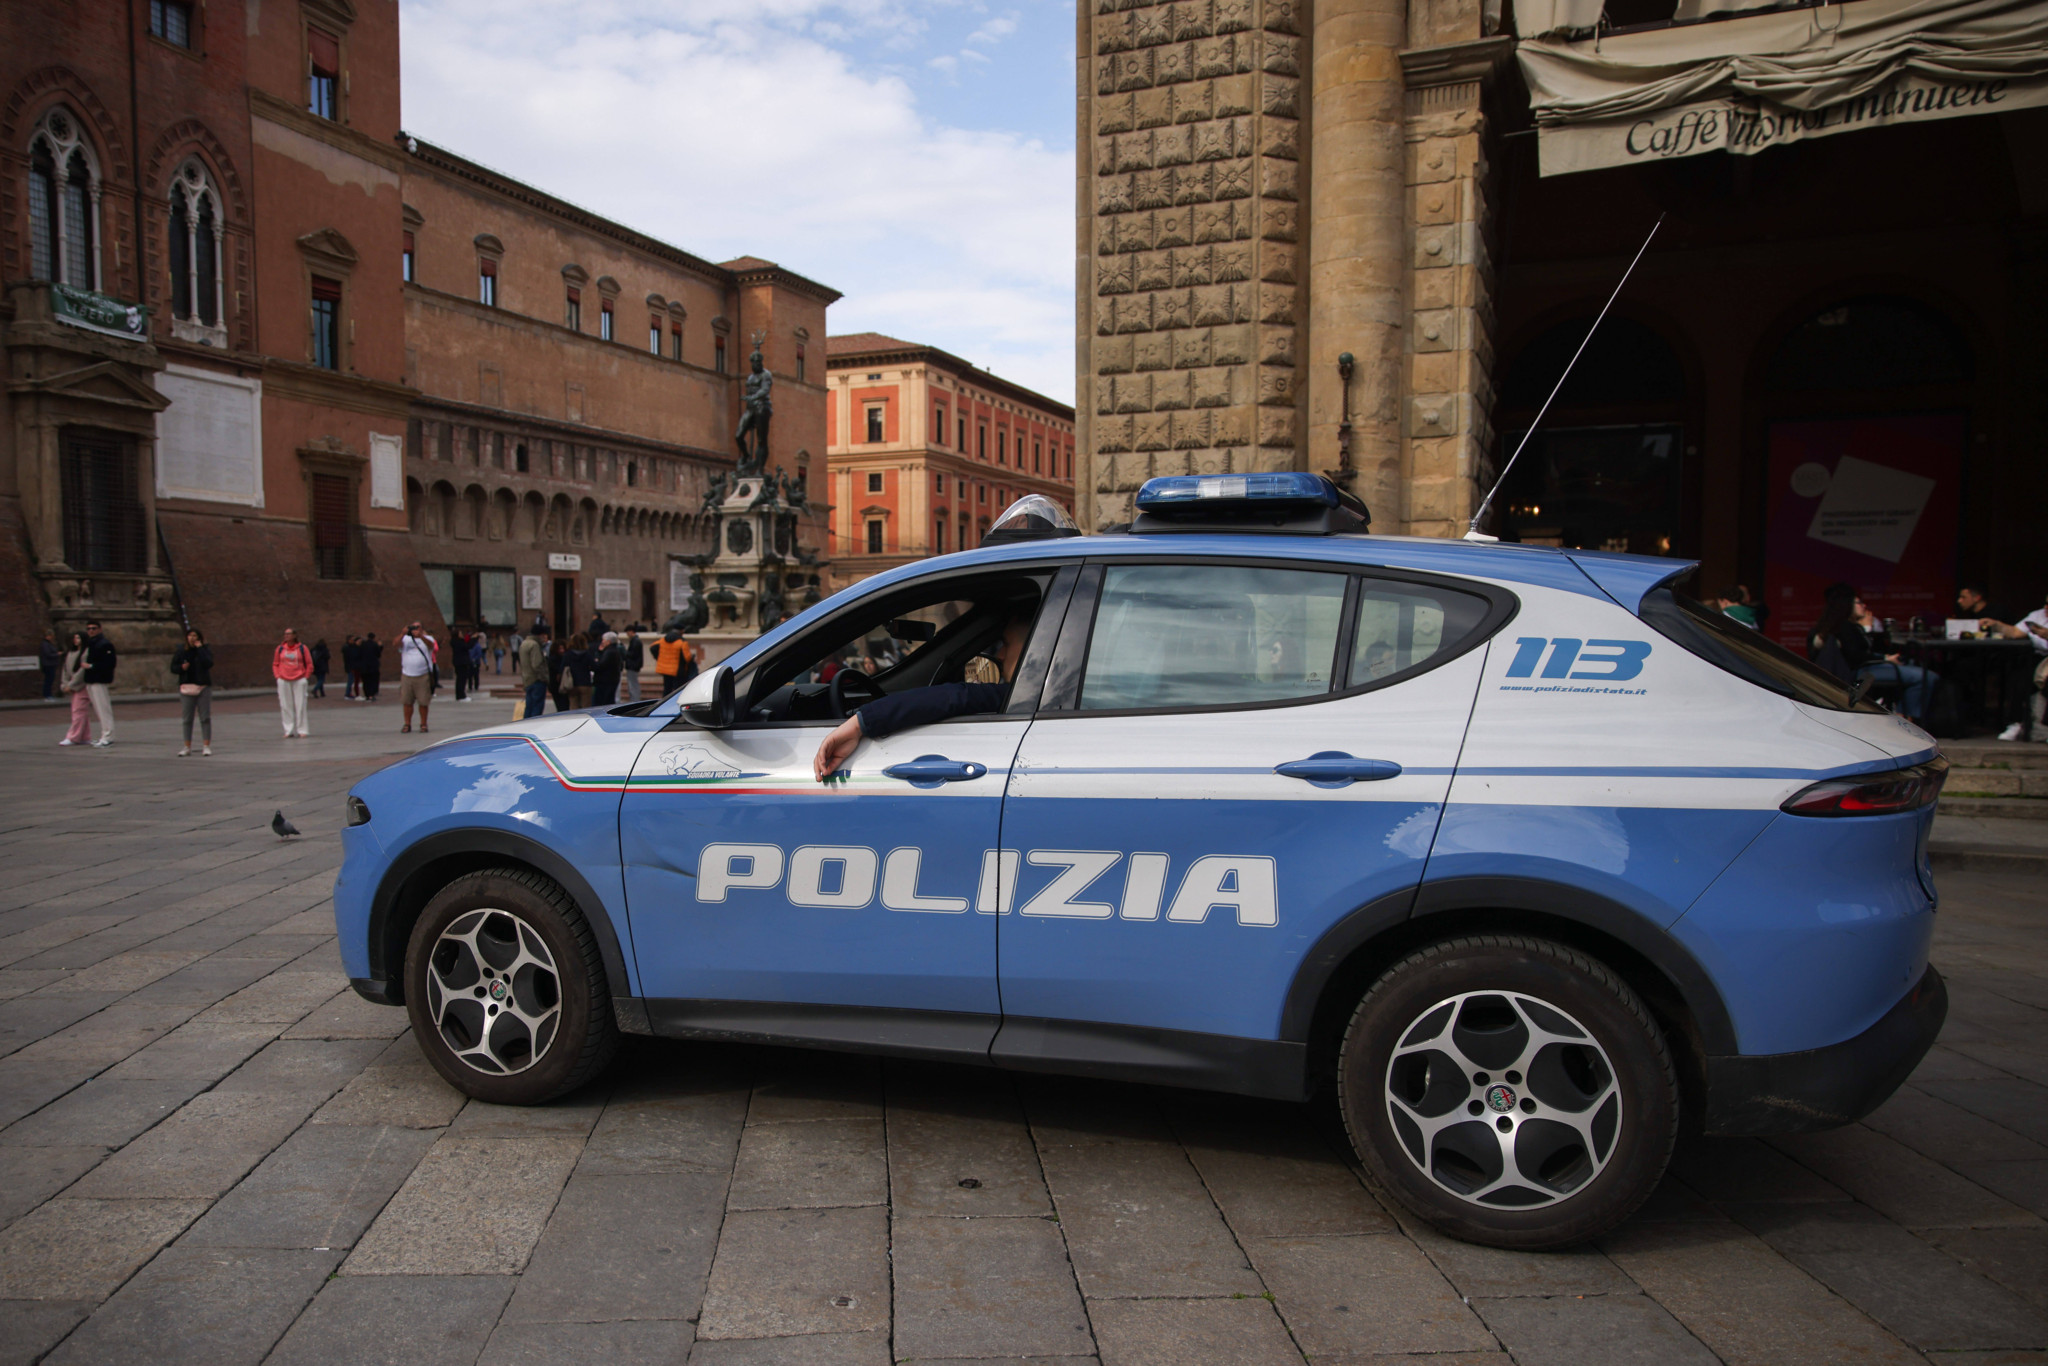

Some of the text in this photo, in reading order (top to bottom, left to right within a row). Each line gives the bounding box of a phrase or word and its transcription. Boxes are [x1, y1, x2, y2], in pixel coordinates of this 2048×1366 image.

[65, 301, 115, 324] LIBERO
[1505, 636, 1653, 681] 113
[687, 770, 741, 779] SQUADRA VOLANTE
[695, 841, 1280, 928] POLIZIA
